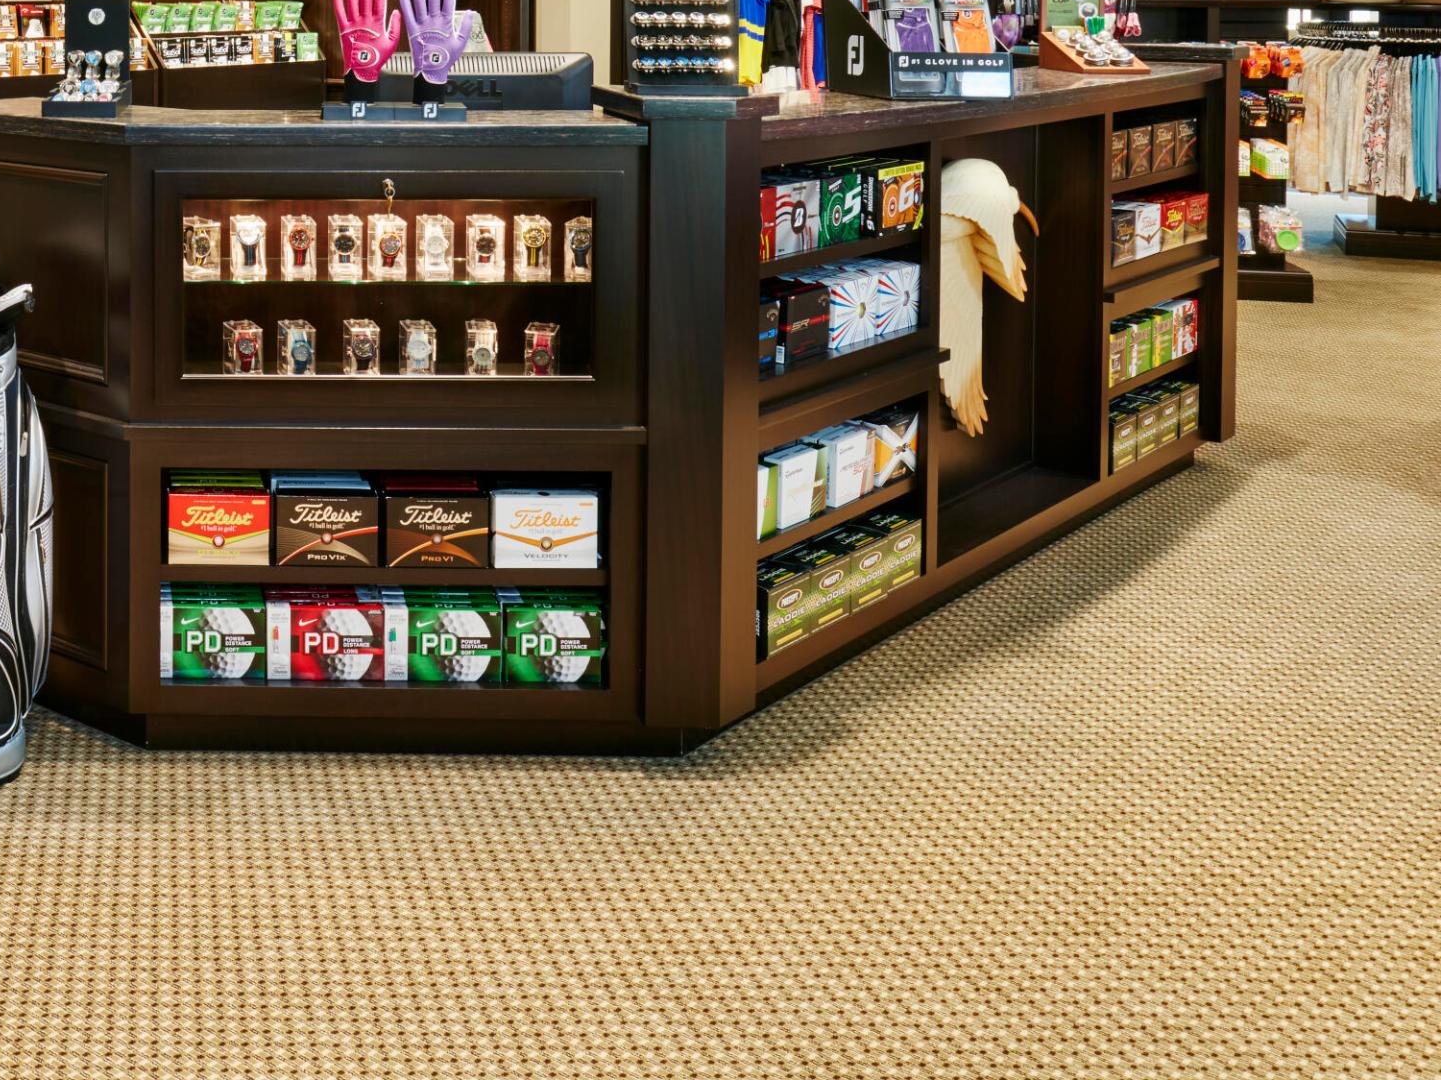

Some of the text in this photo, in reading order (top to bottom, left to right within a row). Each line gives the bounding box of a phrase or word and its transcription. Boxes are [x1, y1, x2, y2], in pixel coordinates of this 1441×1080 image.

[847, 34, 864, 76] FJ
[898, 55, 909, 68] FJ
[925, 58, 958, 66] GLOVE
[351, 102, 366, 118] FJ
[423, 102, 438, 119] FJ
[842, 185, 861, 224] 5
[181, 505, 254, 527] Titleist
[289, 503, 362, 524] Titleist
[400, 505, 472, 526] Titleist
[510, 509, 582, 529] Titleist
[186, 630, 222, 653] PD
[304, 632, 339, 654] PD
[421, 633, 458, 656] PD
[520, 633, 558, 656] PD
